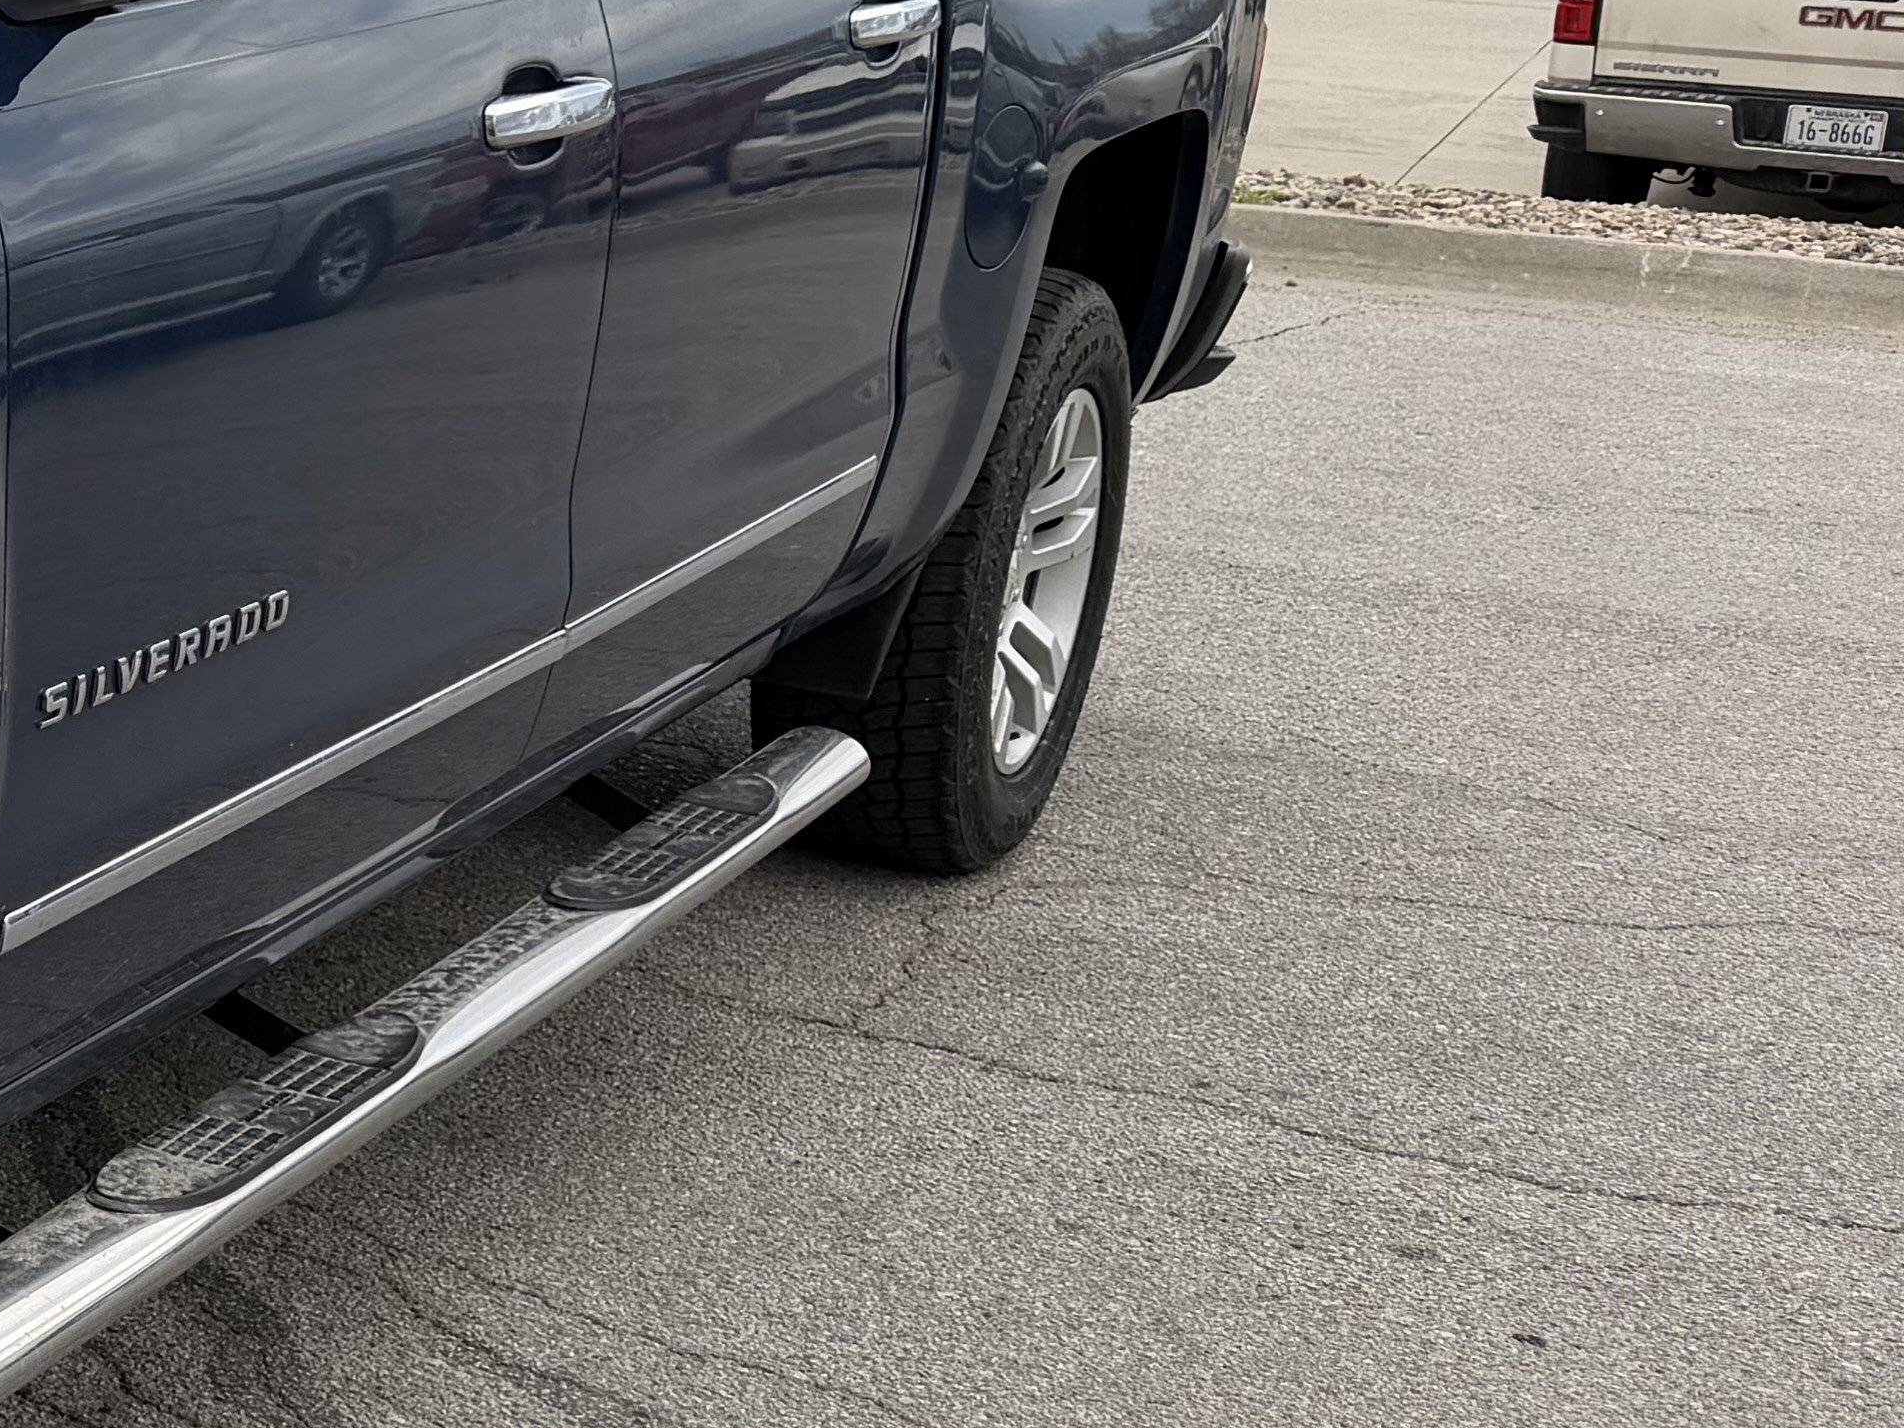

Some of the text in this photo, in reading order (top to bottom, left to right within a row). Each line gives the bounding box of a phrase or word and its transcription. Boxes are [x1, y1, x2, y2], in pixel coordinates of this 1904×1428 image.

[1798, 5, 1904, 33] GMC
[1798, 119, 1875, 145] 16-866G
[34, 589, 291, 730] SILVERADO
